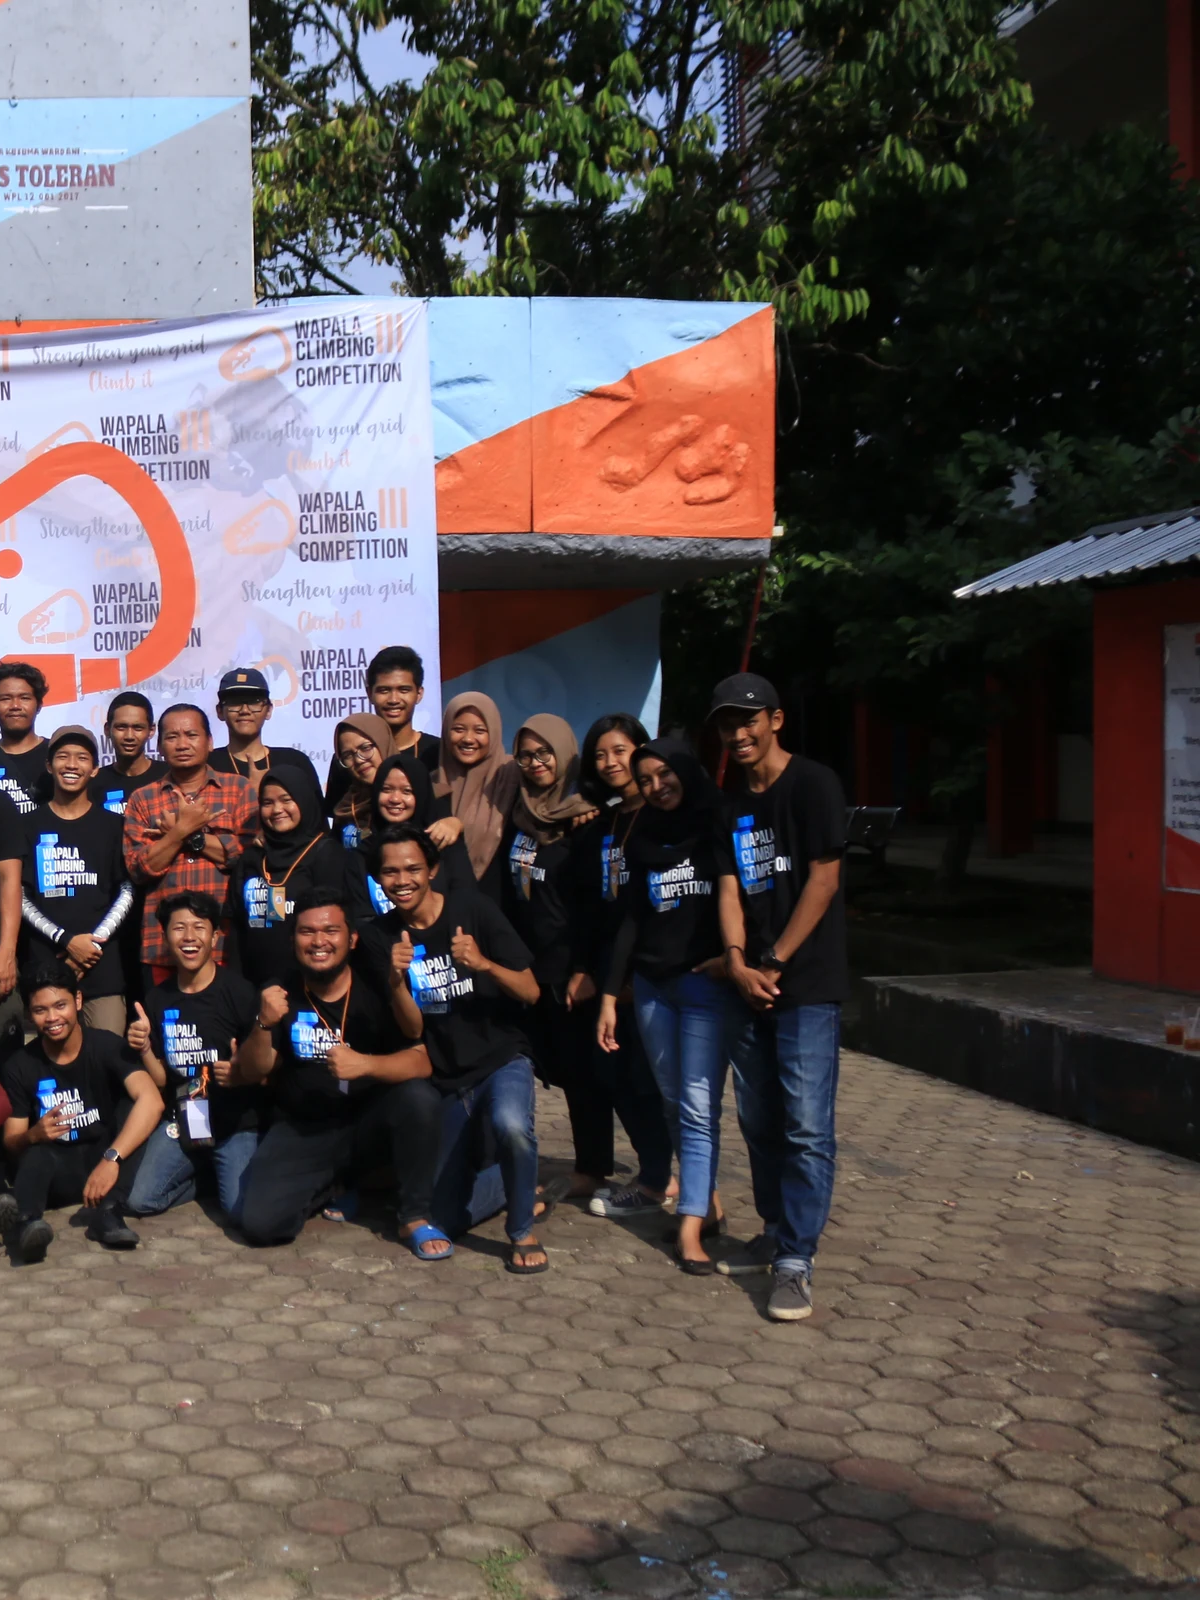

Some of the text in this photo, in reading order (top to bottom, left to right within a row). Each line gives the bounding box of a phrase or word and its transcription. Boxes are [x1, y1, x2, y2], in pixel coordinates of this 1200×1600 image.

[15, 163, 116, 188] TOLERAN
[4, 192, 22, 201] WPL
[58, 192, 80, 200] 2017
[295, 316, 362, 339] WAPALA
[33, 343, 125, 367] Strengthen
[166, 334, 207, 361] grid
[296, 336, 374, 361] CLIMBING
[89, 370, 135, 392] Climb
[296, 362, 402, 388] COMPETITION
[100, 414, 166, 436] WAPALA
[367, 413, 406, 441] grid
[299, 490, 364, 513] WAPALA
[40, 516, 131, 544] Strengthen
[300, 512, 377, 535] CLIMBING
[300, 538, 408, 562] COMPETITION
[92, 582, 159, 604] WAPALA
[242, 574, 417, 606] Strengthen your grid
[94, 603, 160, 626] CLIMBIN
[301, 648, 368, 670] WAPALA
[171, 668, 208, 696] grid
[302, 669, 368, 692] CLIMBIN
[42, 847, 80, 860] WAPALA
[43, 860, 85, 873] CLIMBING
[166, 1024, 197, 1038] WAPALA
[167, 1037, 202, 1052] CLIMBING
[42, 1088, 80, 1108] WAPALA
